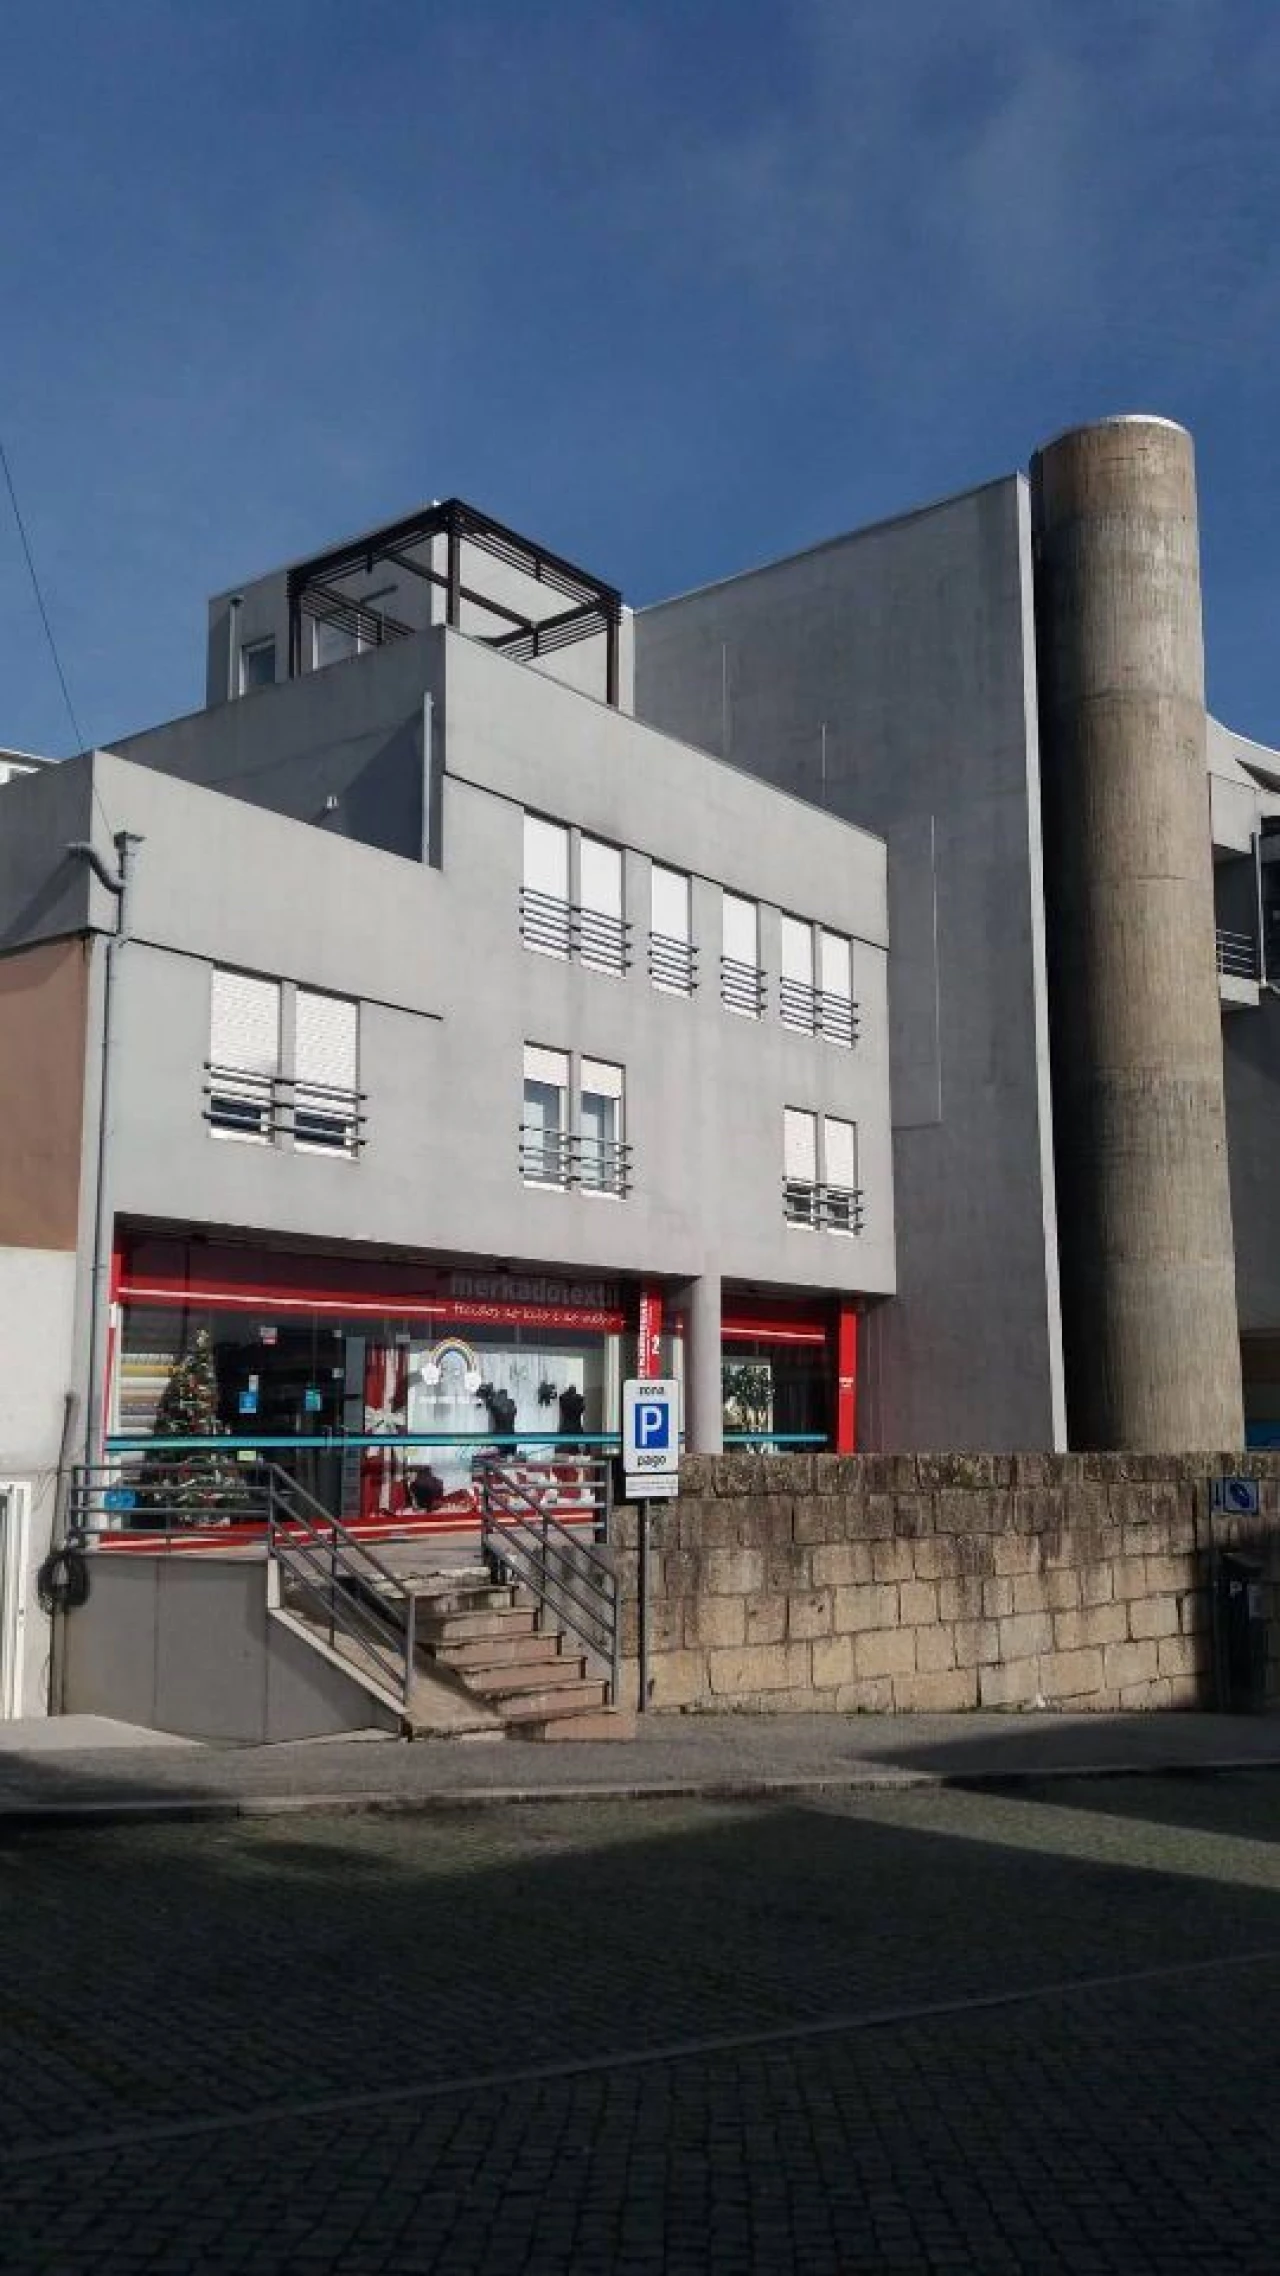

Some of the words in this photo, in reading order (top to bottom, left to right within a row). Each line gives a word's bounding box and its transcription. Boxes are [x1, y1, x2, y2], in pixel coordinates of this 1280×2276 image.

[639, 1386, 665, 1395] zona
[640, 1405, 662, 1447] P
[637, 1455, 667, 1468] pago
